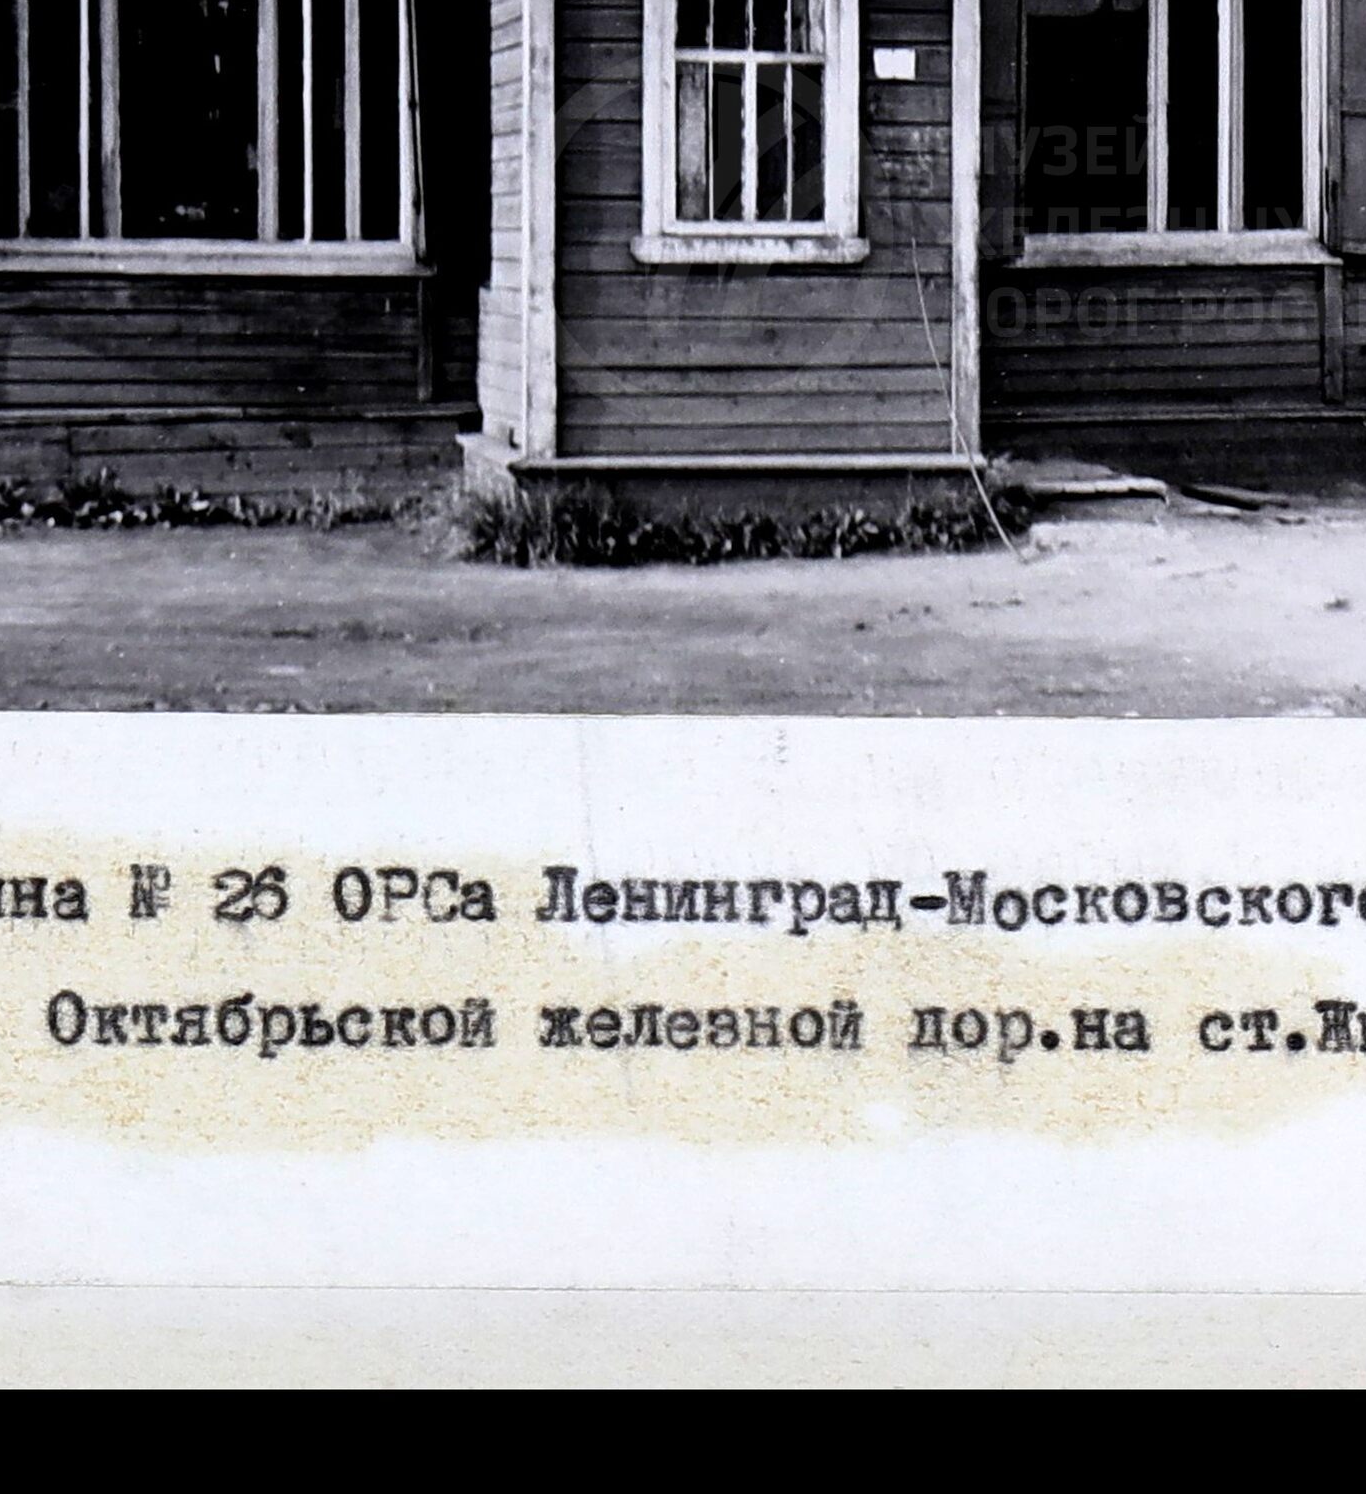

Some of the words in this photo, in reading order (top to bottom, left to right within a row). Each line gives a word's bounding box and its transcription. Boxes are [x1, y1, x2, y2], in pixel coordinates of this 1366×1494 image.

[212, 865, 289, 924] 26
[332, 866, 497, 923] ОРСа
[47, 989, 495, 1059] Октябрьской
[539, 999, 864, 1051] железной
[908, 1006, 1151, 1064] дор.на
